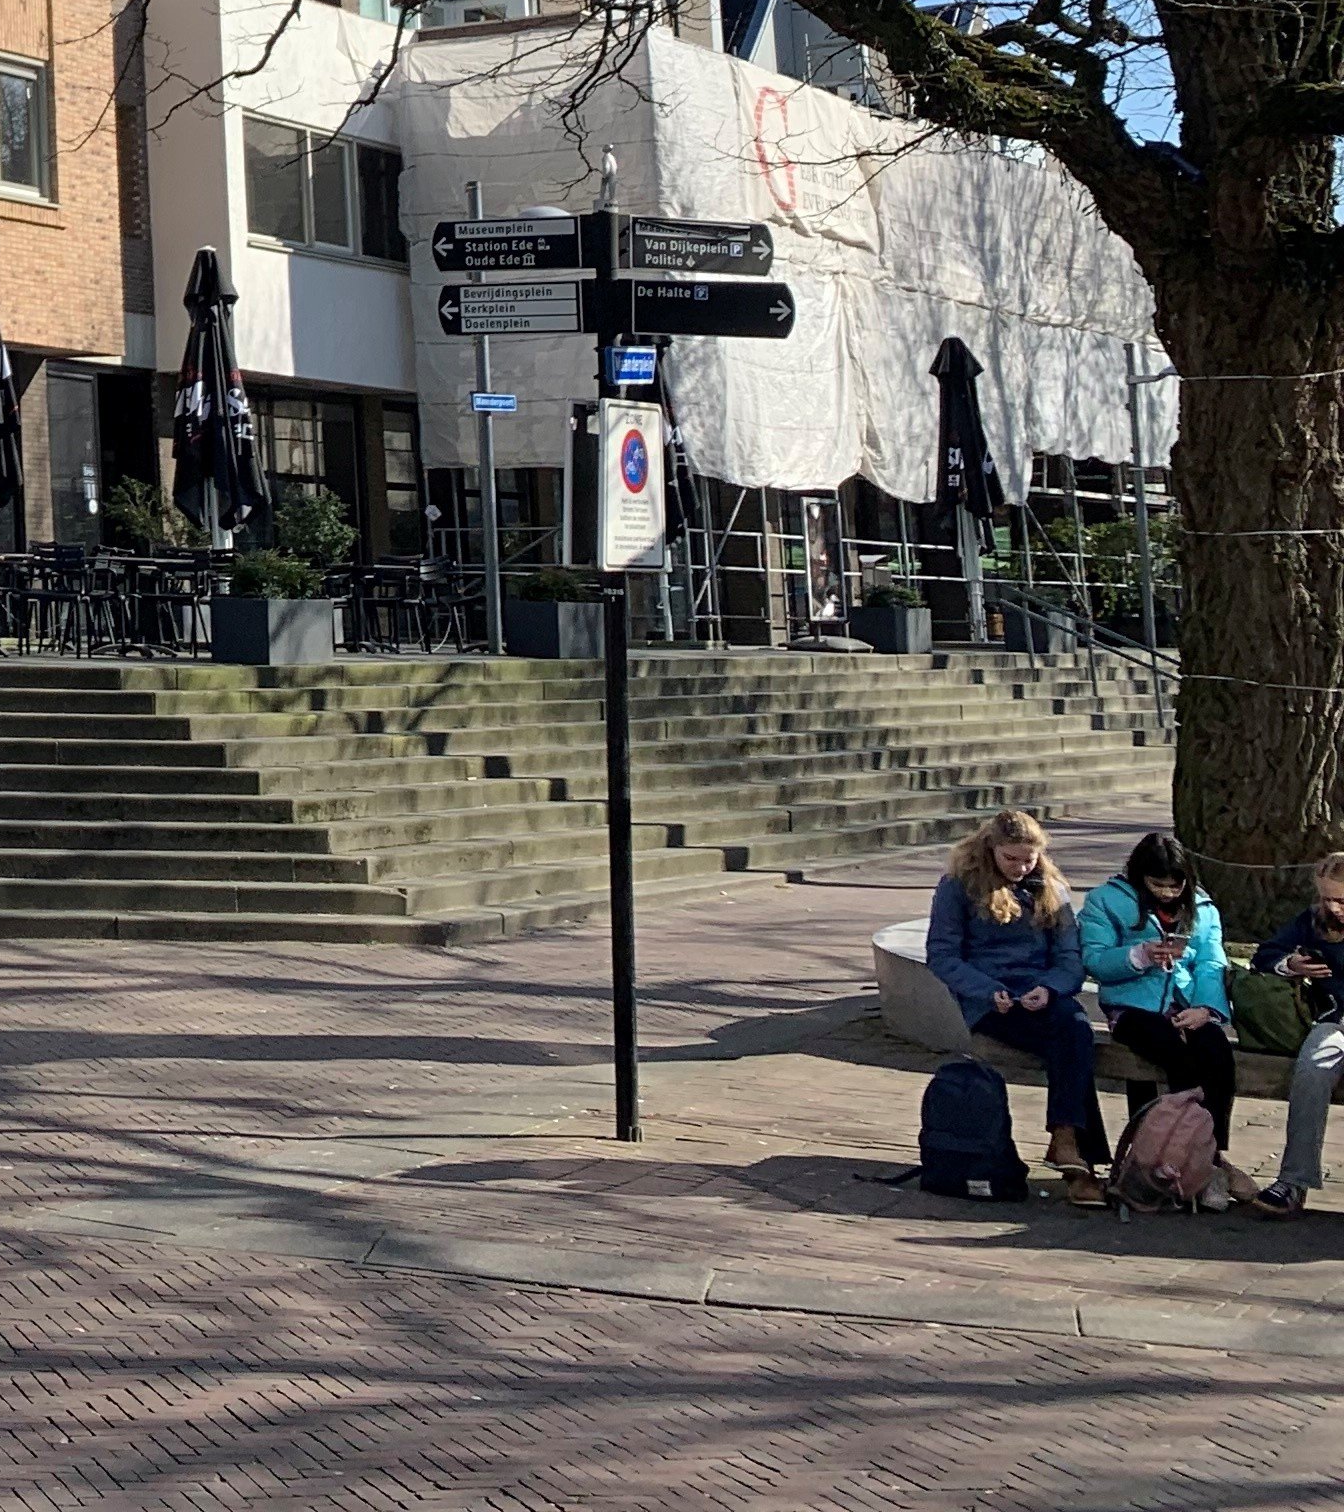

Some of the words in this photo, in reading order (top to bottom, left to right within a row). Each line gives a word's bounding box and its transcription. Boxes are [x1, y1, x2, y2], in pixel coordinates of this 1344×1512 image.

[458, 224, 533, 235] Museumplein
[465, 241, 508, 253] Station
[512, 240, 533, 251] Ede
[645, 239, 664, 250] Van
[670, 241, 728, 255] Dijkeplein
[465, 255, 496, 266] Oude
[499, 254, 520, 265] Ede
[645, 254, 683, 266] Politie
[463, 288, 552, 300] Bevrijdingsplein
[637, 286, 653, 297] De
[658, 286, 691, 298] Halte
[464, 304, 516, 315] Kerkplein
[465, 319, 530, 330] Doelenplein
